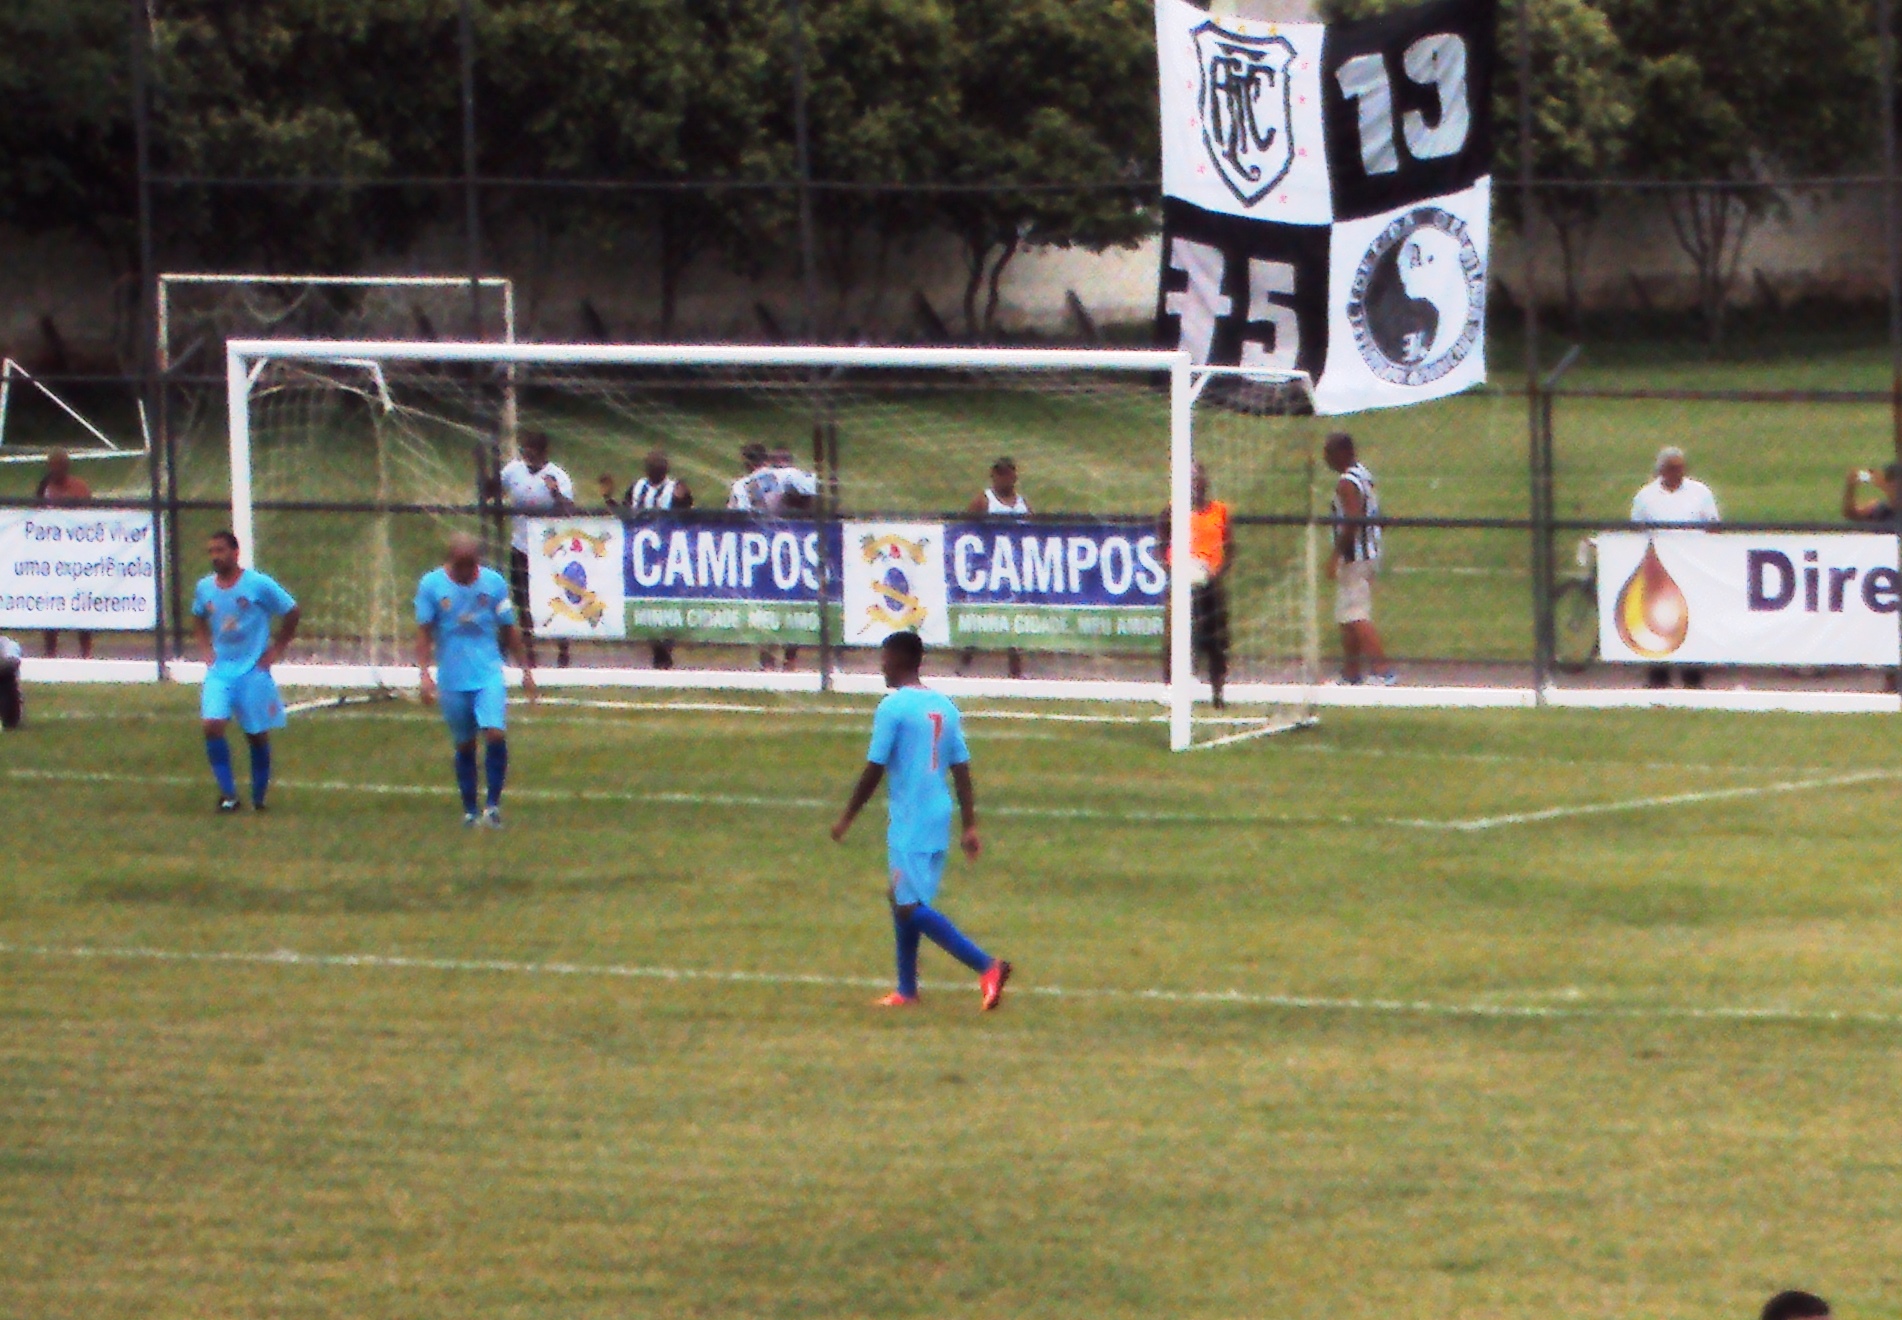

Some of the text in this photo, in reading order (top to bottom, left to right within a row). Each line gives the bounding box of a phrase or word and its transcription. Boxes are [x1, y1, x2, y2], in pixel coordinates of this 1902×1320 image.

[1165, 236, 1300, 383] 75
[25, 521, 62, 541] Para
[632, 528, 831, 591] CAMPOS
[14, 560, 51, 576] uma
[954, 534, 1167, 595] CAMPOS
